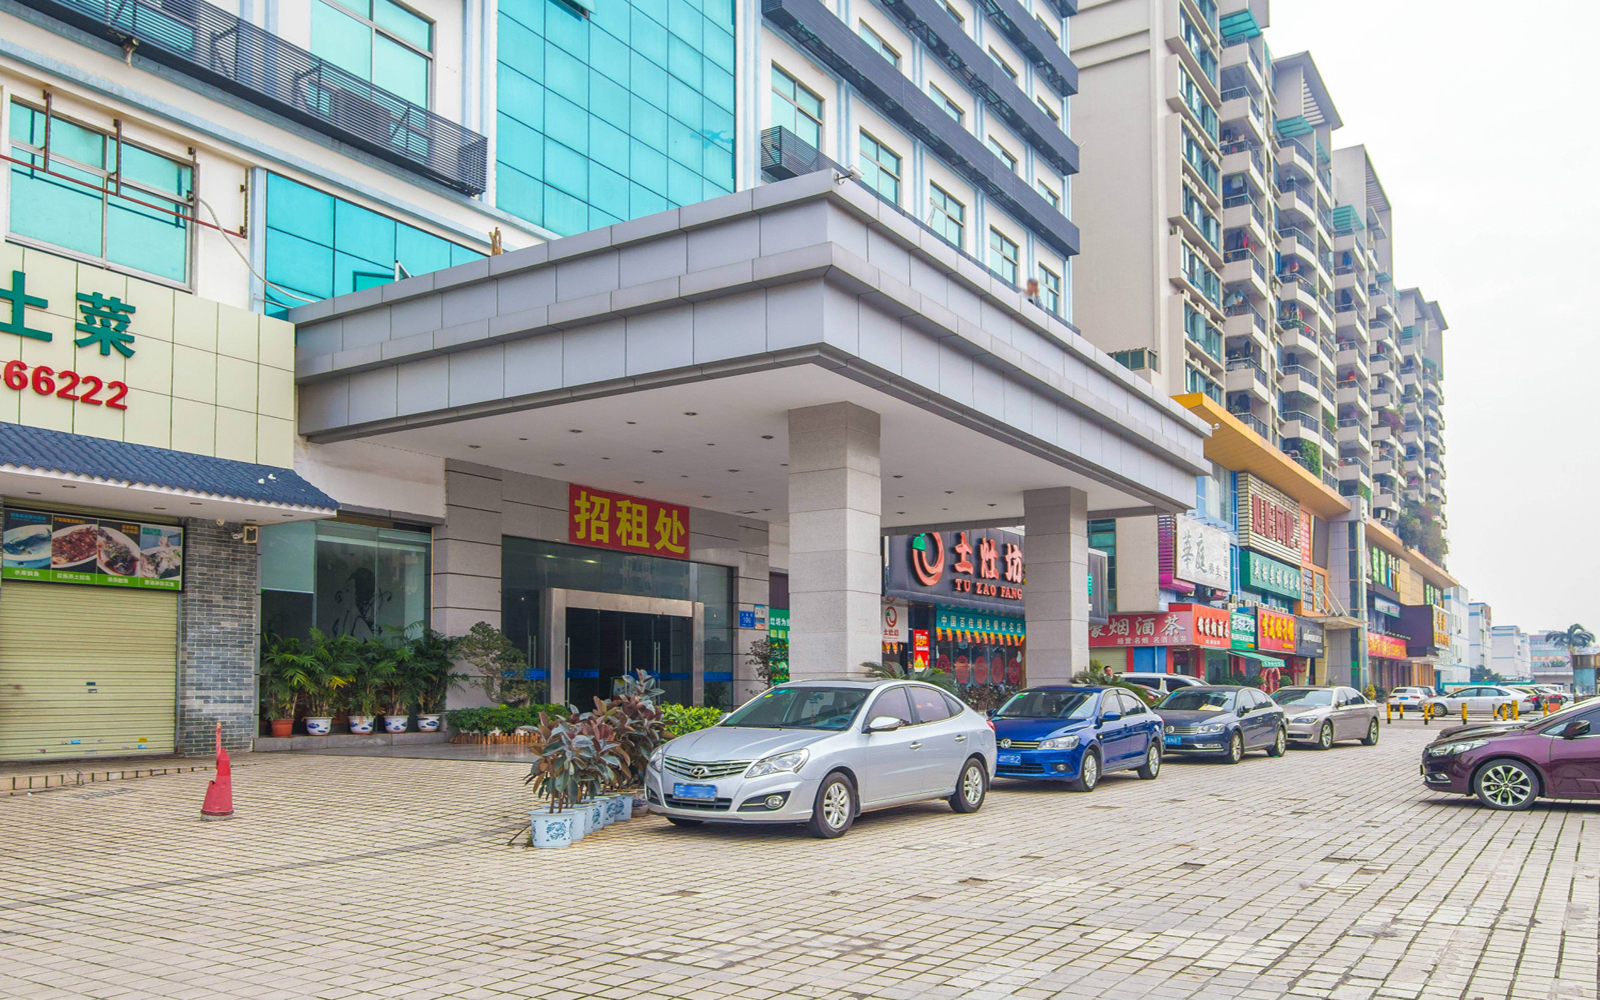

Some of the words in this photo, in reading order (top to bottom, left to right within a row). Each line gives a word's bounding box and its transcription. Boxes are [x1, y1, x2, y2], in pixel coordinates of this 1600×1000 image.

[0, 270, 136, 358] 土菜
[0, 360, 128, 410] 66222
[574, 490, 686, 554] 招租处
[954, 531, 1023, 584] 土灶坊
[955, 578, 971, 593] TU
[976, 582, 997, 597] ZAO
[1000, 585, 1023, 600] FANG
